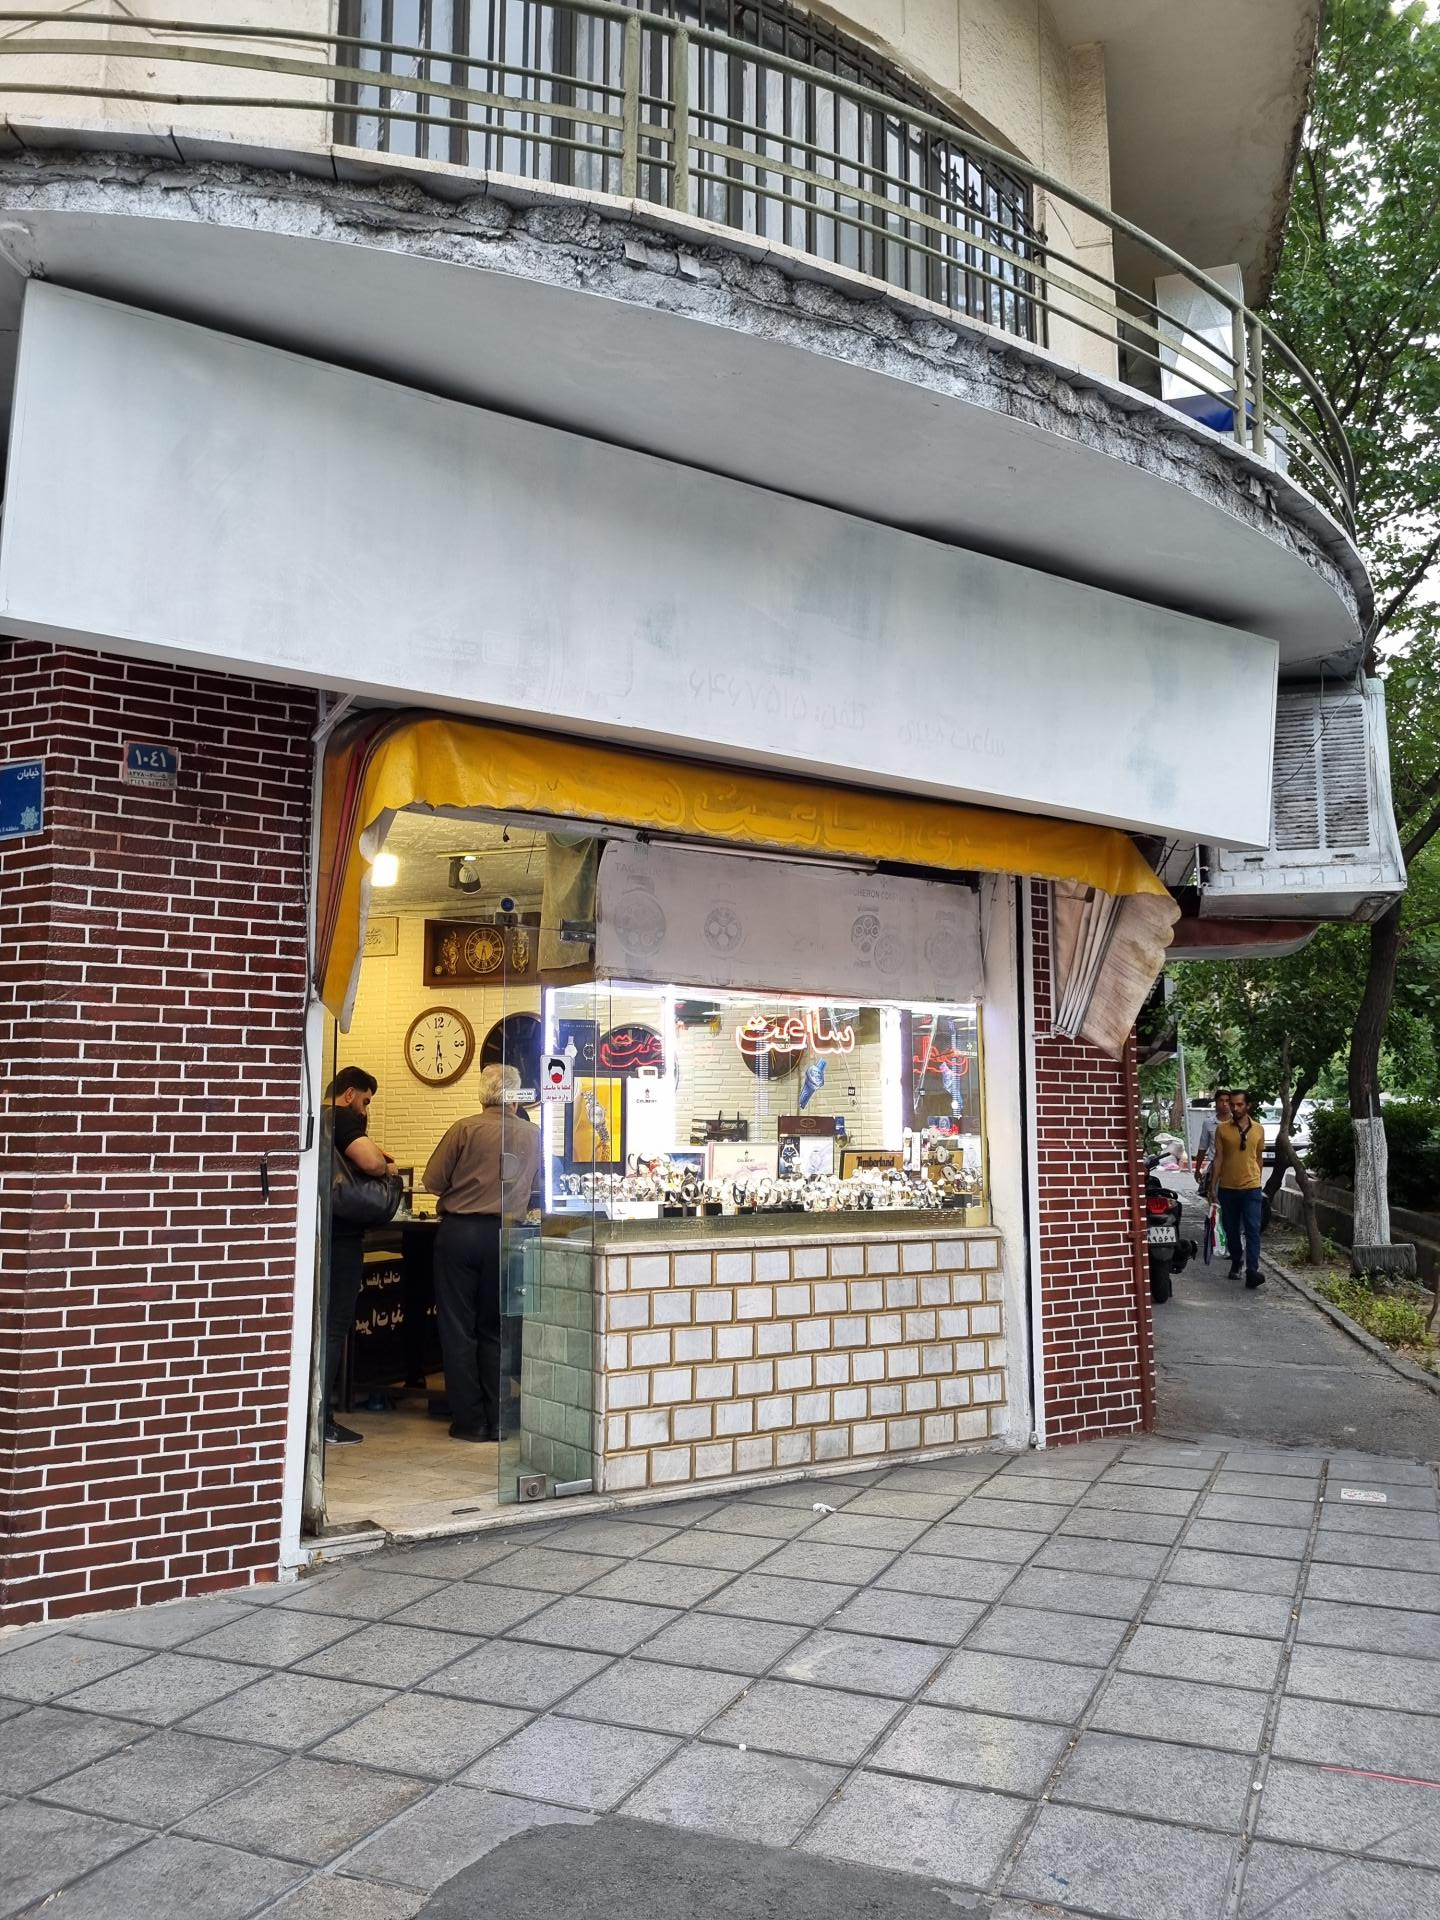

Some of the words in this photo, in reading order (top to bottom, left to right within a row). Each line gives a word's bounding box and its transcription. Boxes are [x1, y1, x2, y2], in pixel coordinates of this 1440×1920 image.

[16, 766, 40, 781] خیابان
[434, 1016, 444, 1029] 12
[734, 1006, 856, 1056] ساعت
[436, 1062, 444, 1075] 6
[856, 1154, 895, 1167] Timberland
